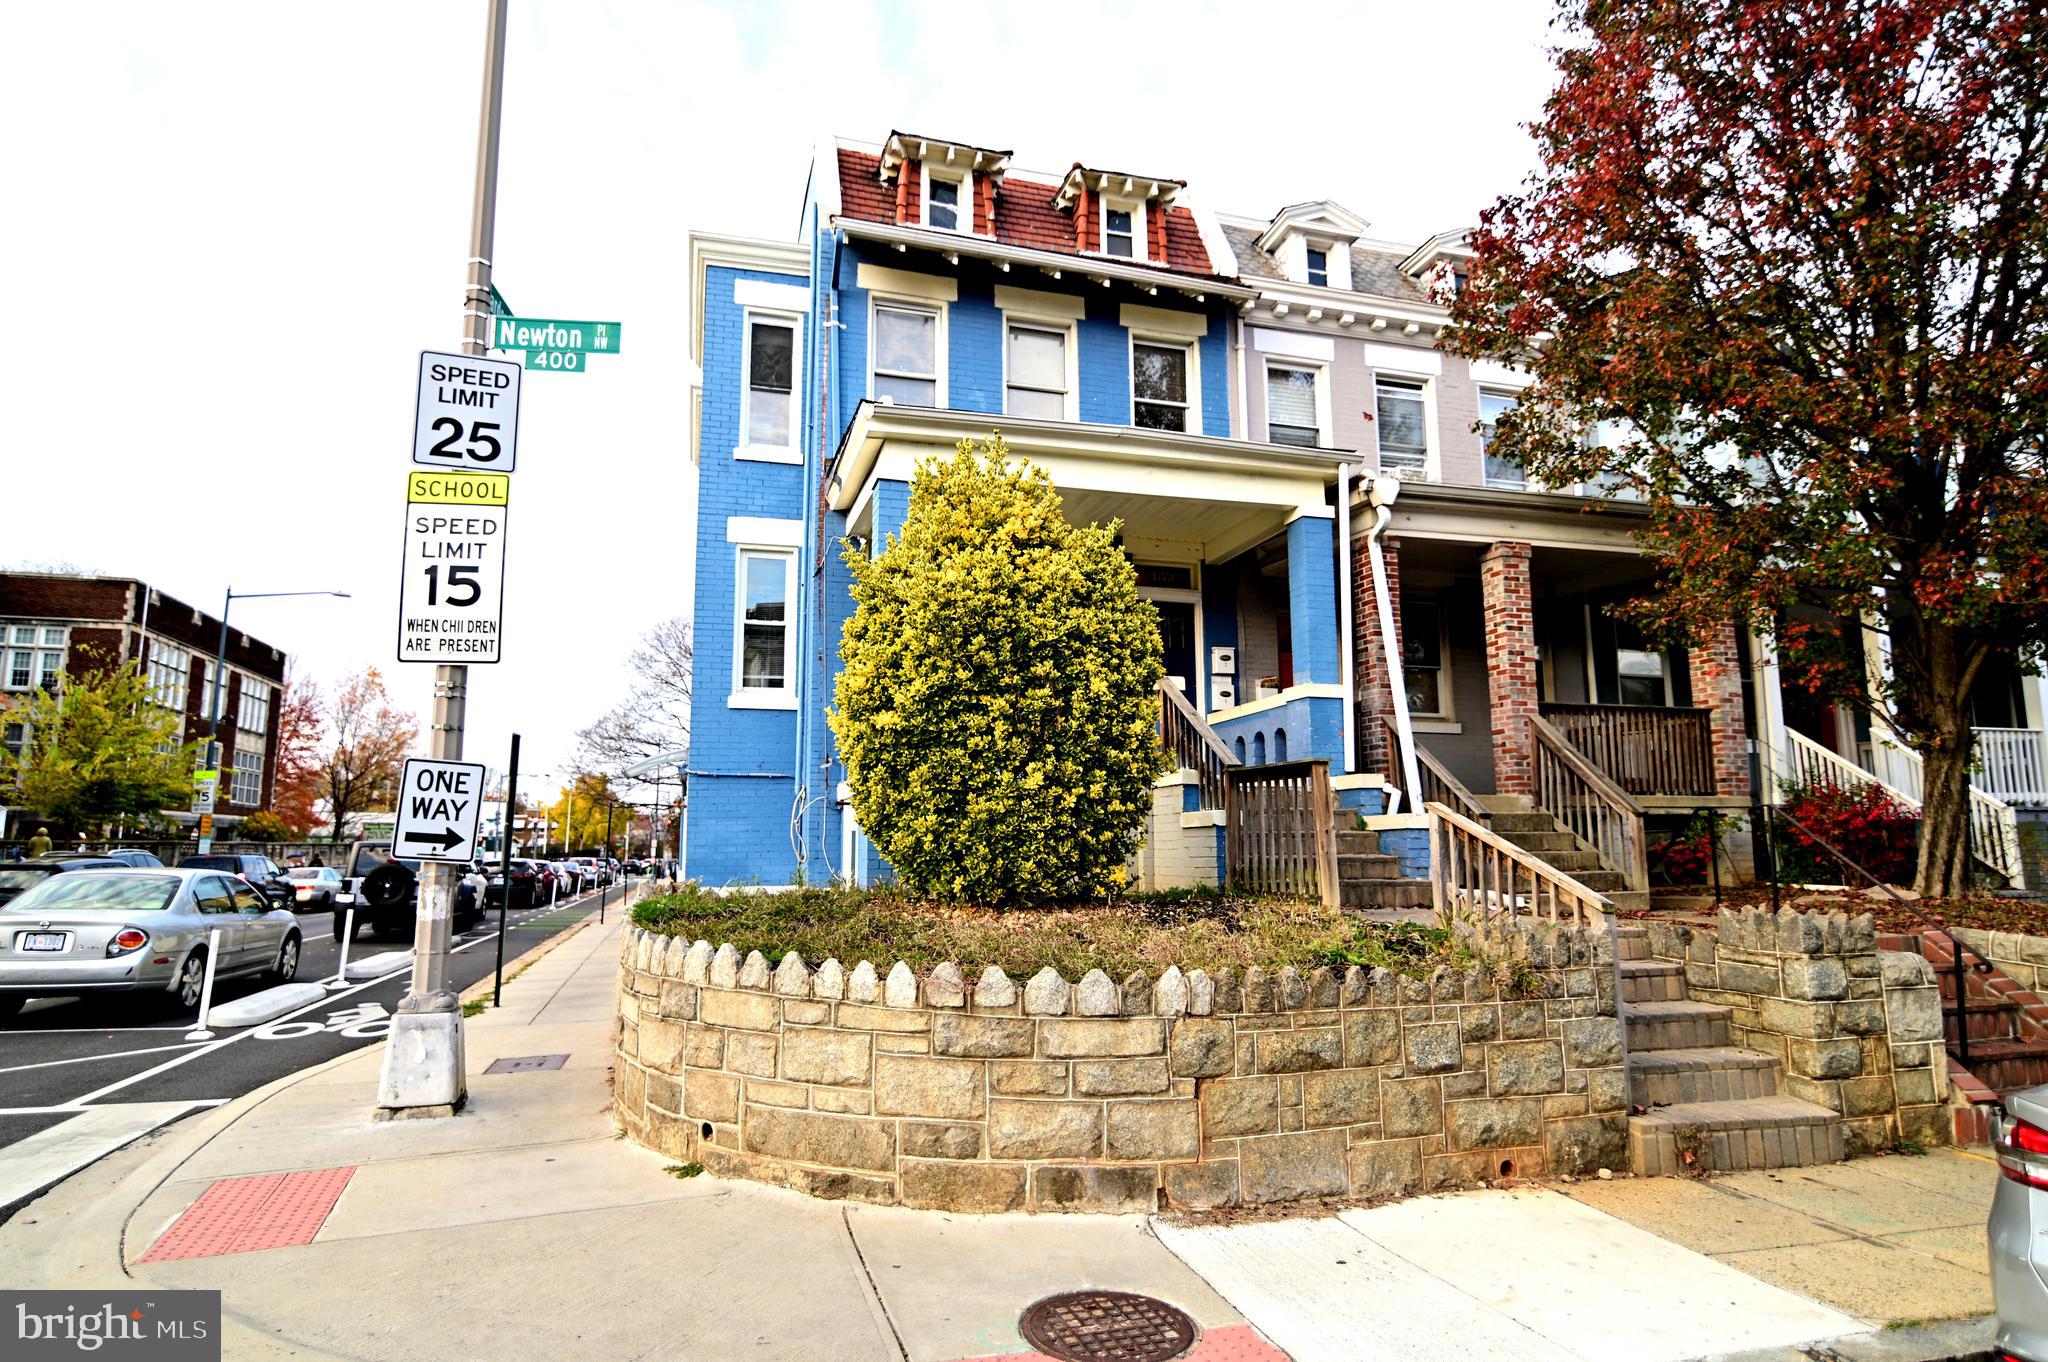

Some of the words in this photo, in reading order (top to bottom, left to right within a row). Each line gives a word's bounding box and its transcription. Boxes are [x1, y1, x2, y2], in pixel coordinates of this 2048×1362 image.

[500, 320, 582, 348] Newton
[594, 337, 608, 350] NW
[534, 352, 577, 369] 400
[430, 364, 510, 390] SPEED
[438, 386, 501, 409] LIMIT
[428, 416, 502, 464] 25
[414, 479, 503, 500] SCHOOL
[415, 517, 497, 536] SPEED
[421, 541, 488, 560] LIMIT
[424, 565, 482, 608] 15
[407, 618, 439, 633] WHEN
[405, 637, 432, 652] ARE
[439, 638, 496, 653] PRESENT
[417, 769, 471, 793] ONE
[413, 797, 469, 821] WAY
